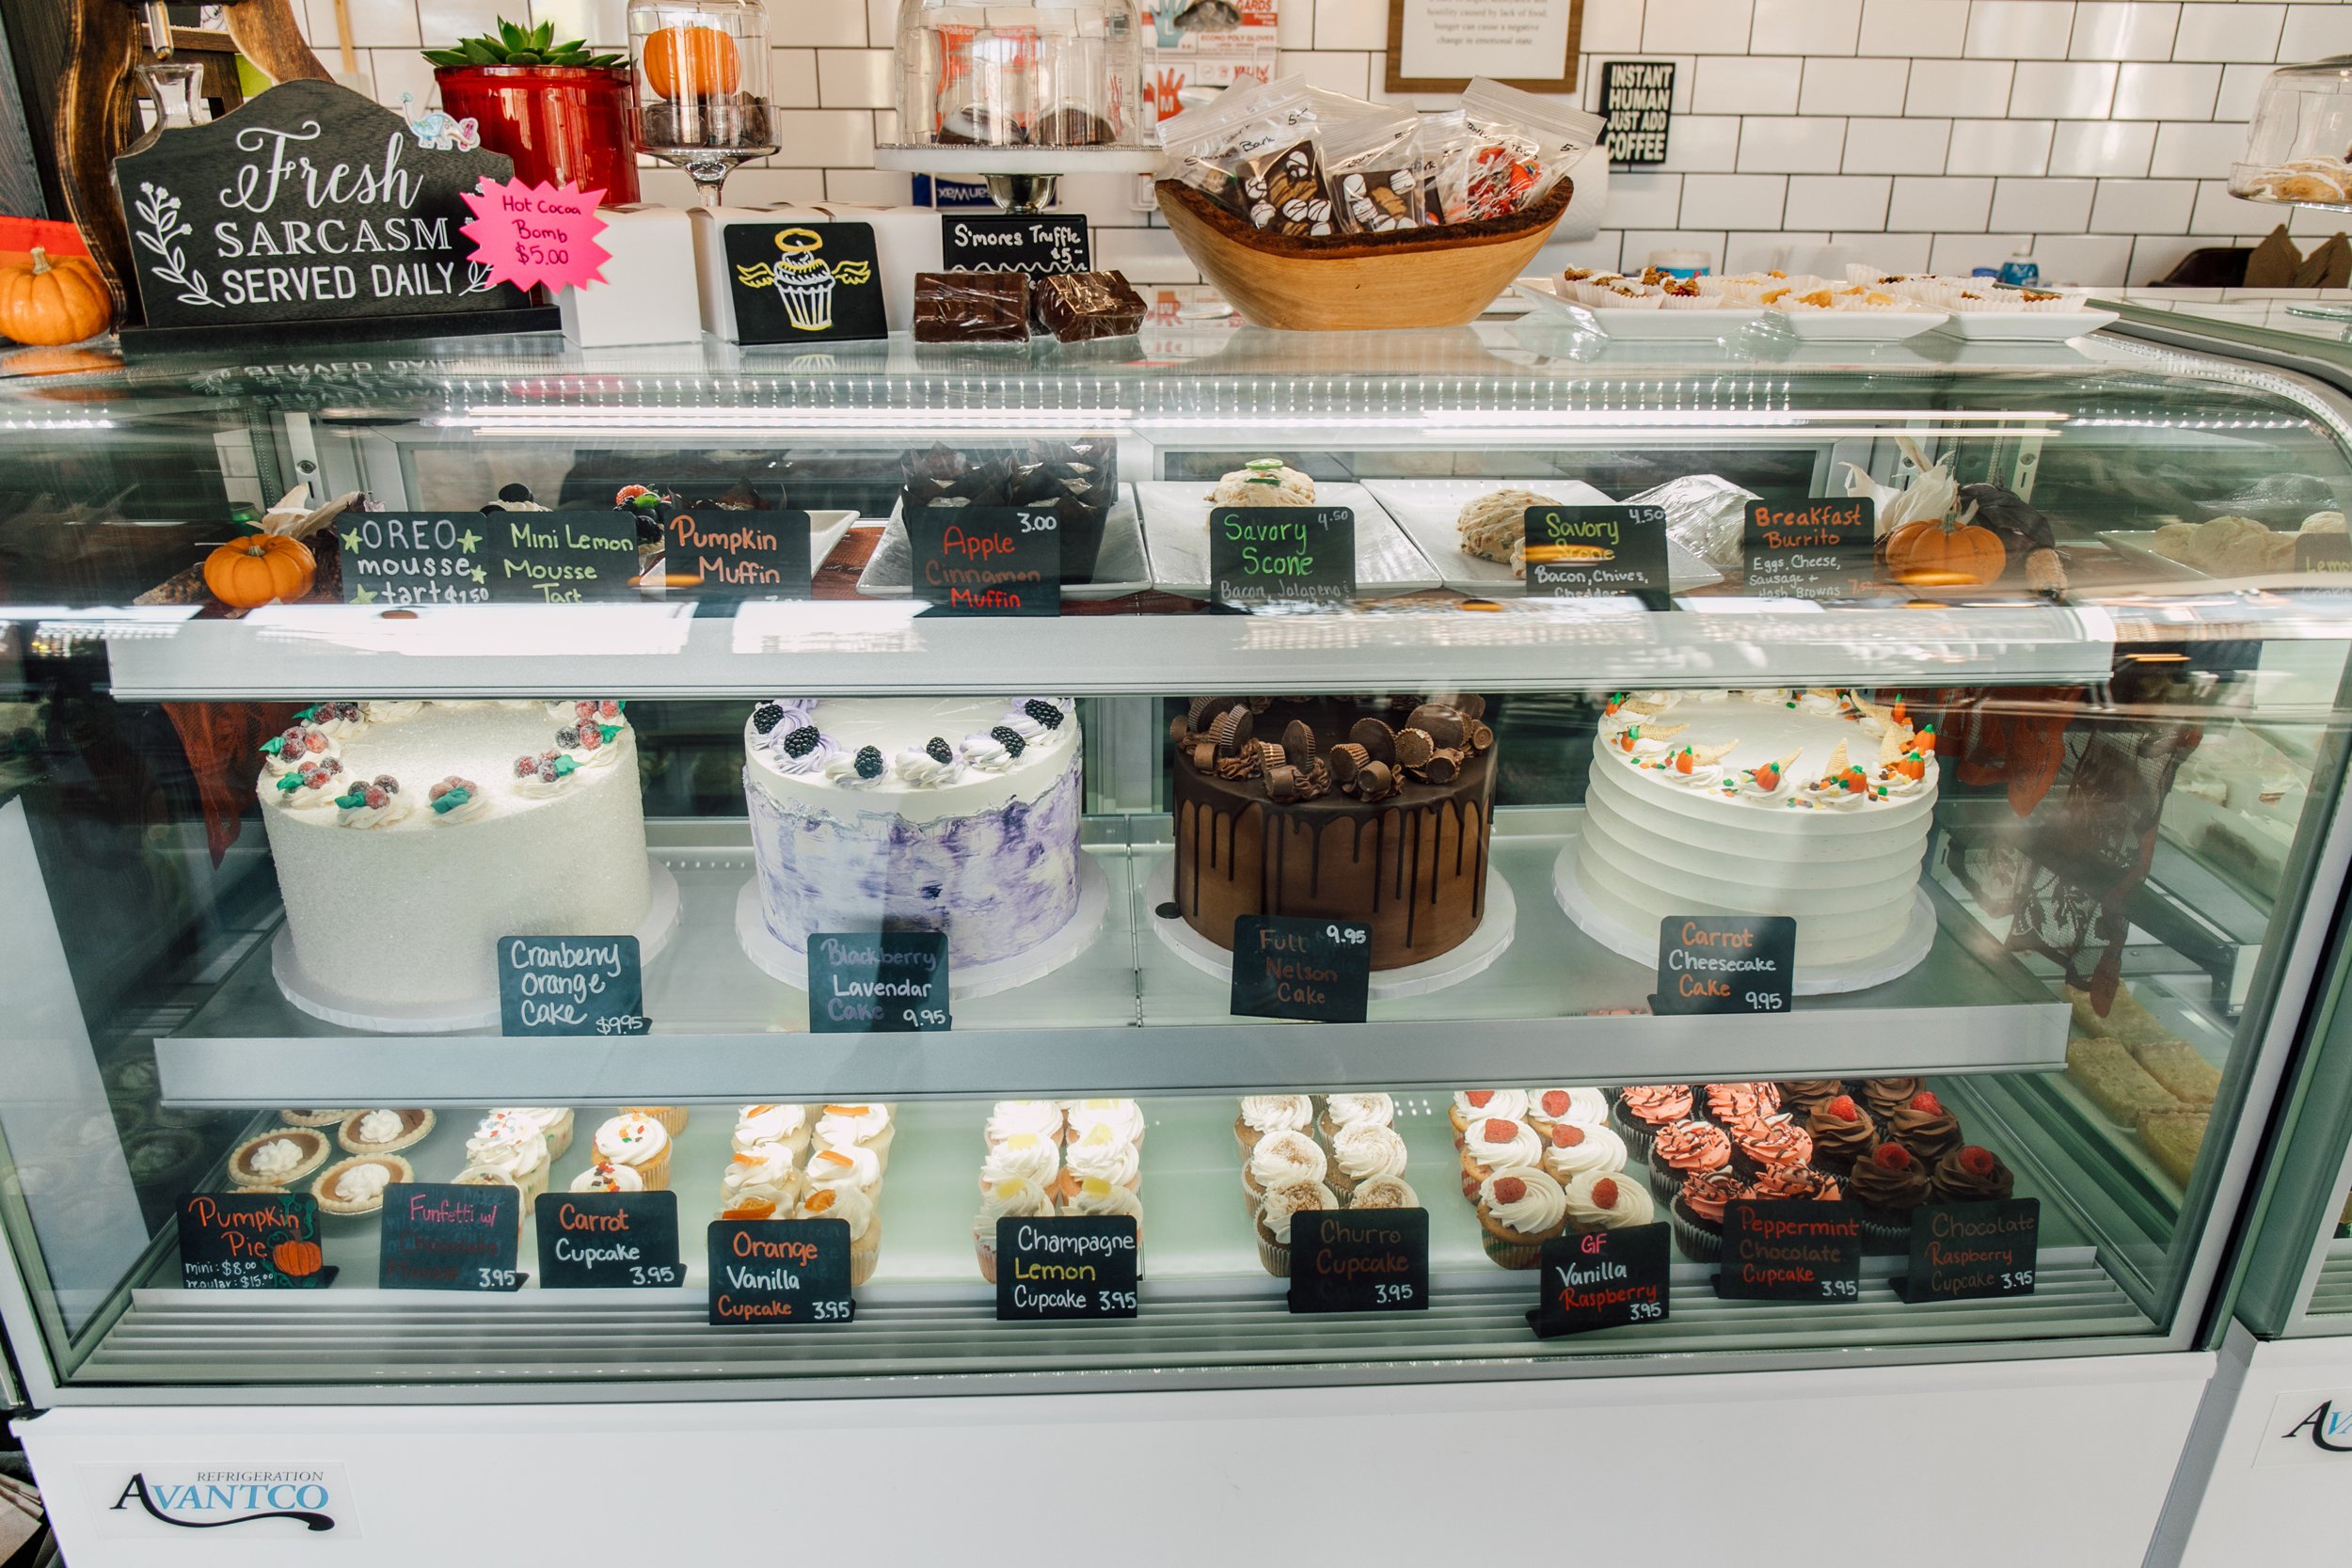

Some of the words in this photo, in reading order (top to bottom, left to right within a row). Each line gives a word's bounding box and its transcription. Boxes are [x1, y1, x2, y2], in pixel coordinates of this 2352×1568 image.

[1611, 64, 1673, 88] INSTANT
[1609, 87, 1670, 111] HUMAN
[1607, 111, 1640, 131] JUST
[1641, 111, 1667, 131] ADD
[1239, 135, 1276, 152] Bark
[1605, 132, 1665, 161] COFFEE
[219, 120, 423, 214] Fresh
[502, 195, 532, 213] Hot
[537, 199, 581, 215] Cocoa
[215, 217, 453, 258] SARCASM
[511, 219, 567, 244] Bomb
[1029, 224, 1081, 247] Truffle
[516, 242, 569, 265] $5.00
[222, 265, 357, 305] SERVED
[371, 261, 454, 298] DAILY
[1016, 513, 1057, 533] 3.00
[1317, 510, 1348, 531] 4.50
[1629, 509, 1665, 525] 4.50
[1755, 503, 1862, 528] Breakfast
[361, 519, 456, 550] OREO
[510, 522, 559, 549] Mini
[564, 524, 634, 552] Lemon
[669, 515, 777, 556] Pumpkin
[1224, 514, 1307, 555] Savory
[1546, 513, 1620, 546] Savory
[1762, 528, 1841, 550] Burrito
[943, 526, 1015, 565] Apple
[1555, 539, 1616, 562] Scone
[358, 557, 472, 578] mousse
[503, 559, 597, 580] Mousse
[698, 556, 781, 585] Muffin
[925, 560, 1041, 586] Cinnamon
[1242, 546, 1313, 576] Scone
[1790, 554, 1841, 571] Cheese,
[1534, 564, 1592, 585] Bacon,
[1593, 569, 1649, 584] Chives,
[1749, 575, 1804, 589] Sausage
[381, 579, 441, 605] tart
[532, 582, 582, 604] Tart
[951, 588, 1021, 610] Muffin
[1758, 587, 1788, 598] Hash
[1796, 587, 1841, 598] Browns
[1259, 929, 1307, 953] Full
[1327, 925, 1367, 944] 9.95
[1681, 922, 1754, 948] Carrot
[511, 940, 621, 977] Cranberry
[820, 938, 936, 972] Blackberry
[1669, 949, 1776, 973] Cheesecake
[1265, 956, 1338, 983] Nelson
[521, 973, 606, 1004] Orange
[834, 974, 932, 998] Lavendar
[1277, 982, 1326, 1005] Cake
[1678, 974, 1731, 997] Cake
[521, 999, 588, 1026] Cake
[827, 997, 885, 1022] Cake
[1745, 991, 1783, 1010] 9.95
[596, 1015, 644, 1035] $9.95
[903, 1009, 946, 1027] 9.95
[188, 1196, 299, 1232] Pumpkin
[409, 1194, 474, 1224] Funfetti
[480, 1205, 497, 1227] w/
[559, 1203, 630, 1231] Carrot
[1320, 1219, 1401, 1243] Churro
[1738, 1206, 1859, 1240] Peppermint
[1931, 1212, 2035, 1238] Chocolate
[221, 1230, 267, 1258] Pie
[733, 1231, 818, 1267] Orange
[1018, 1225, 1136, 1257] Champagne
[1581, 1233, 1608, 1254] GF
[1740, 1239, 1842, 1262] Chocolate
[555, 1238, 640, 1269] Cupcake
[1316, 1248, 1410, 1280] Cupcake
[1924, 1241, 2012, 1266] Raspberry
[478, 1267, 516, 1288] 3.95
[629, 1266, 675, 1285] 3.95
[726, 1265, 800, 1291] Vanilla
[1015, 1257, 1096, 1281] Lemon
[1556, 1261, 1628, 1287] Vanilla
[1742, 1263, 1816, 1287] Cupcake
[1375, 1284, 1413, 1304] 3.95
[1821, 1280, 1857, 1297] 3.95
[1931, 1271, 1995, 1295] Cupcake
[2000, 1271, 2033, 1290] 3.95
[718, 1294, 792, 1321] Cupcake
[812, 1301, 850, 1320] 3.95
[1014, 1284, 1087, 1313] Cupcake
[1099, 1291, 1136, 1310] 3.95
[1559, 1285, 1657, 1313] Raspberry
[1629, 1302, 1661, 1321] 3.95
[197, 1471, 325, 1482] REFRIGERATION
[109, 1472, 335, 1531] AVANTCO
